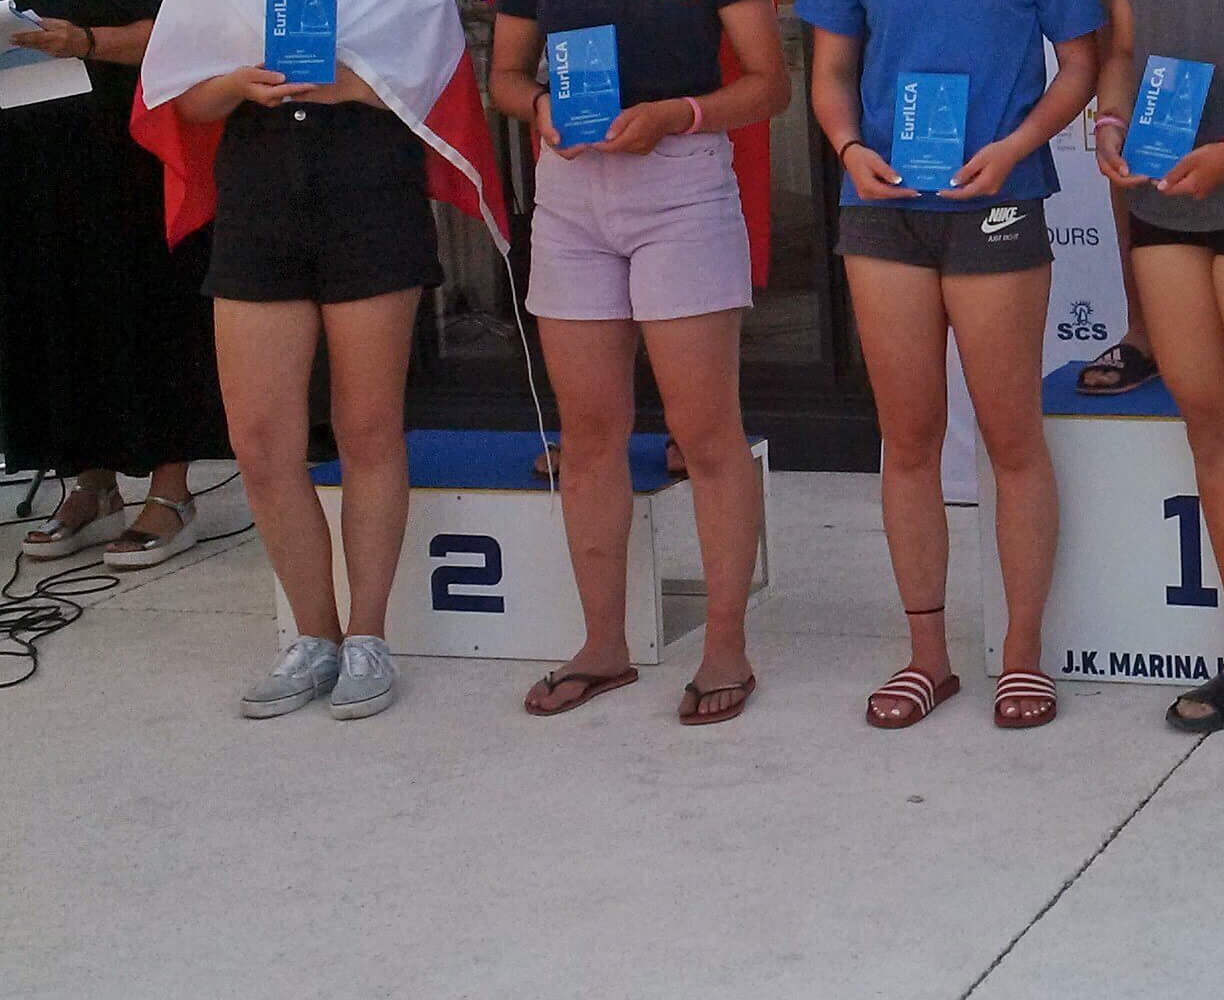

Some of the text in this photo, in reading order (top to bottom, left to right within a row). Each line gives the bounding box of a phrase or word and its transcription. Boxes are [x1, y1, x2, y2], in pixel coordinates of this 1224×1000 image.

[557, 41, 571, 100] EurILCA
[1139, 67, 1166, 126] EurILCA
[901, 82, 918, 141] EurILCA
[989, 207, 1018, 222] NIKE
[1047, 227, 1100, 247] OURS
[429, 532, 505, 614] 2
[1163, 494, 1219, 608] 1
[1062, 650, 1104, 675] J.K.
[1109, 652, 1210, 681] MARINA
